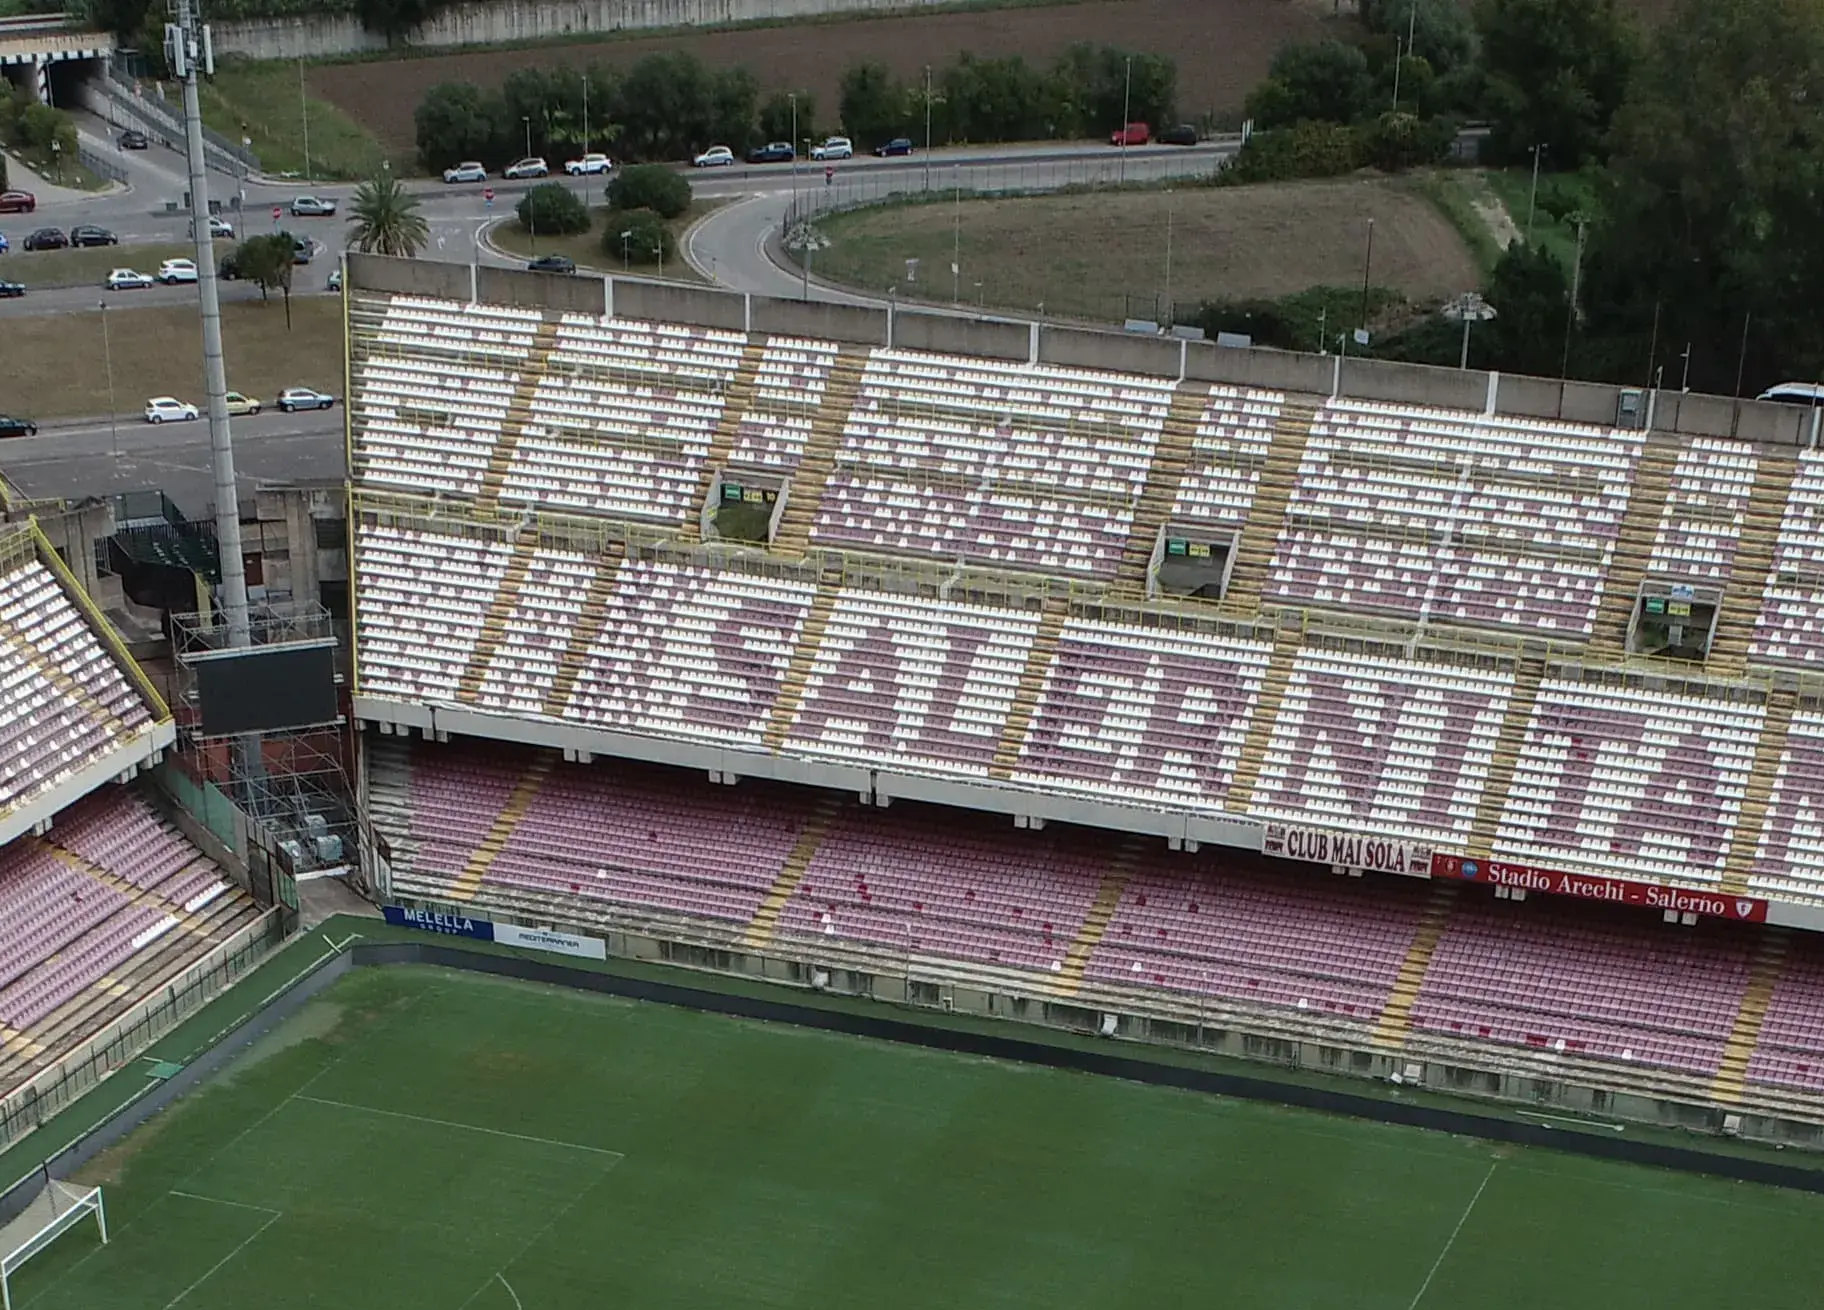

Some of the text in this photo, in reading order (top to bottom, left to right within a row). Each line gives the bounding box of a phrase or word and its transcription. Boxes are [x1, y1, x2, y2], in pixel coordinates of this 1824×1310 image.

[1287, 829, 1328, 861] CLUB
[1331, 835, 1363, 866] MAI
[1364, 839, 1407, 872] SOLA
[1488, 863, 1551, 891] Stadio
[1556, 877, 1625, 901] Arechi
[1645, 886, 1726, 915] Salerno
[404, 908, 474, 932] MELELLA
[420, 923, 458, 935] GROUP
